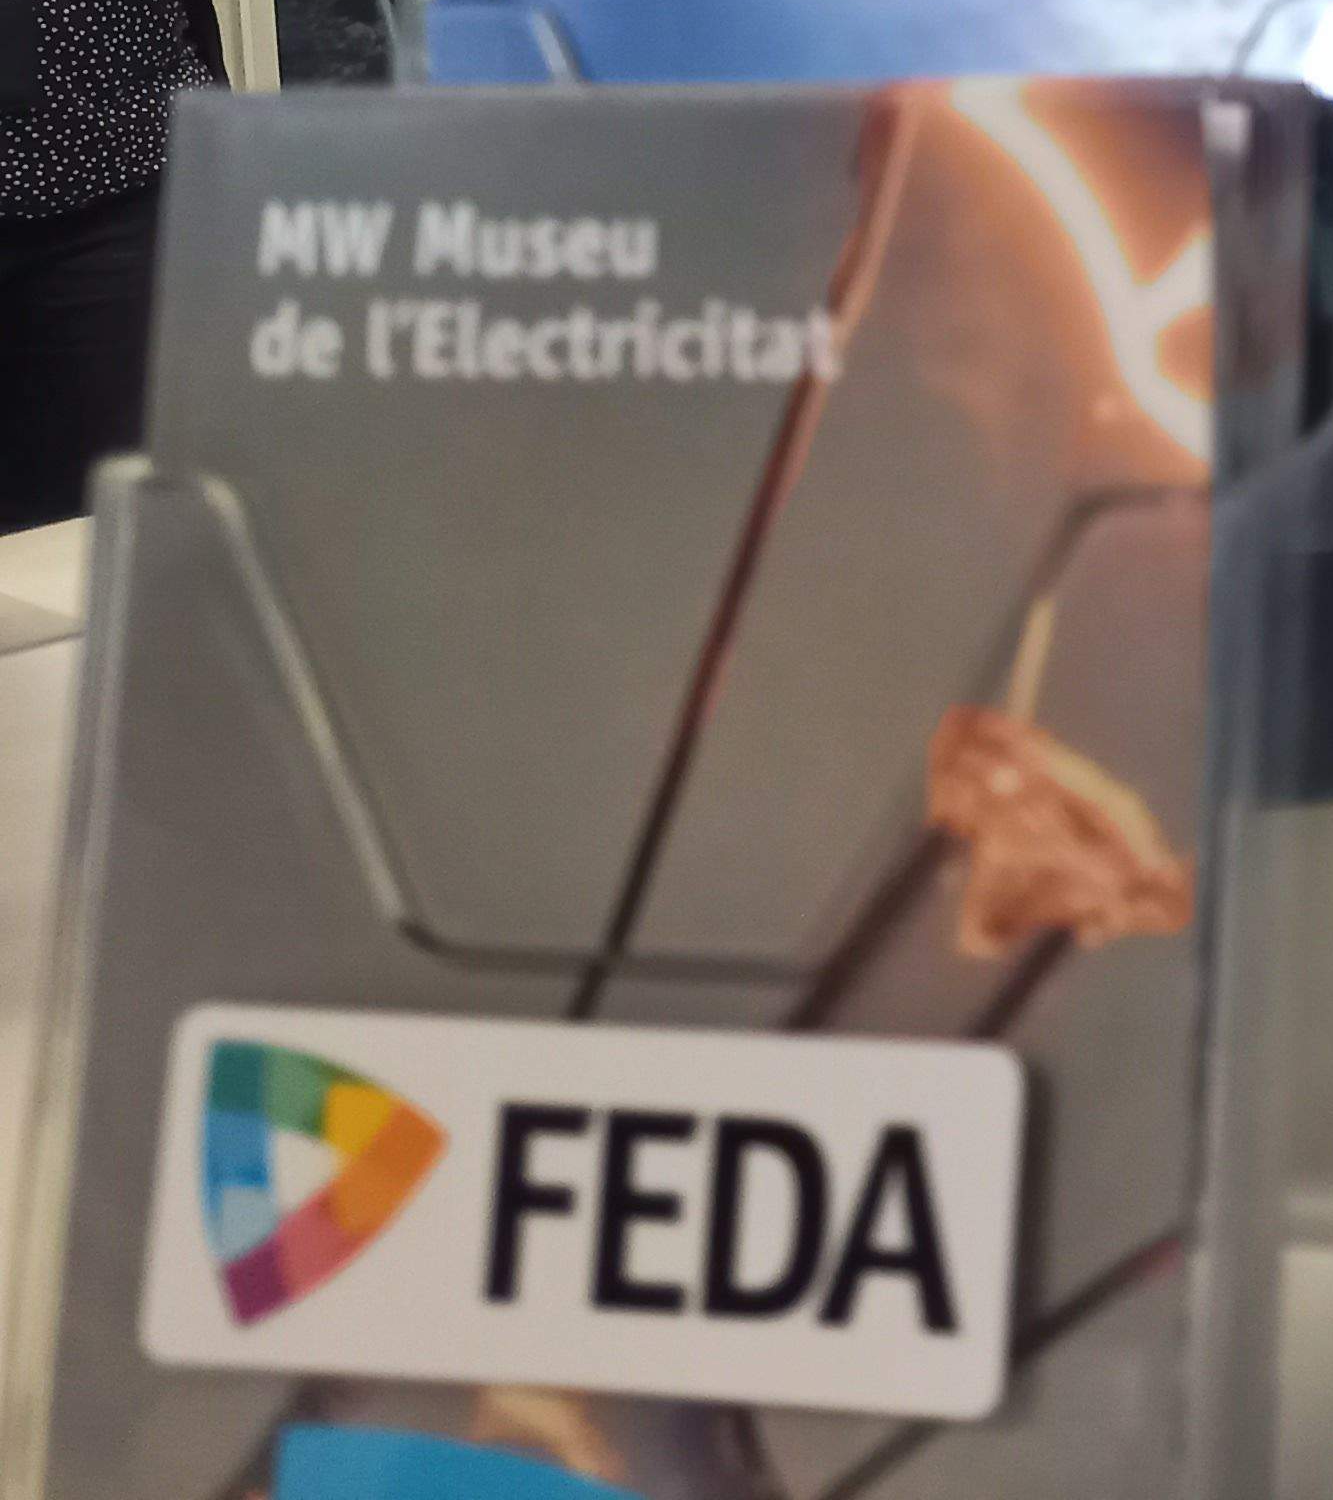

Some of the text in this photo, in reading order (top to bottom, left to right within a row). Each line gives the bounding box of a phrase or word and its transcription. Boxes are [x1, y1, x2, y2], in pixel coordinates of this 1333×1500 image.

[259, 200, 660, 278] MW Museu
[250, 300, 844, 382] de l'Electricitat
[483, 1101, 959, 1336] FEDA
